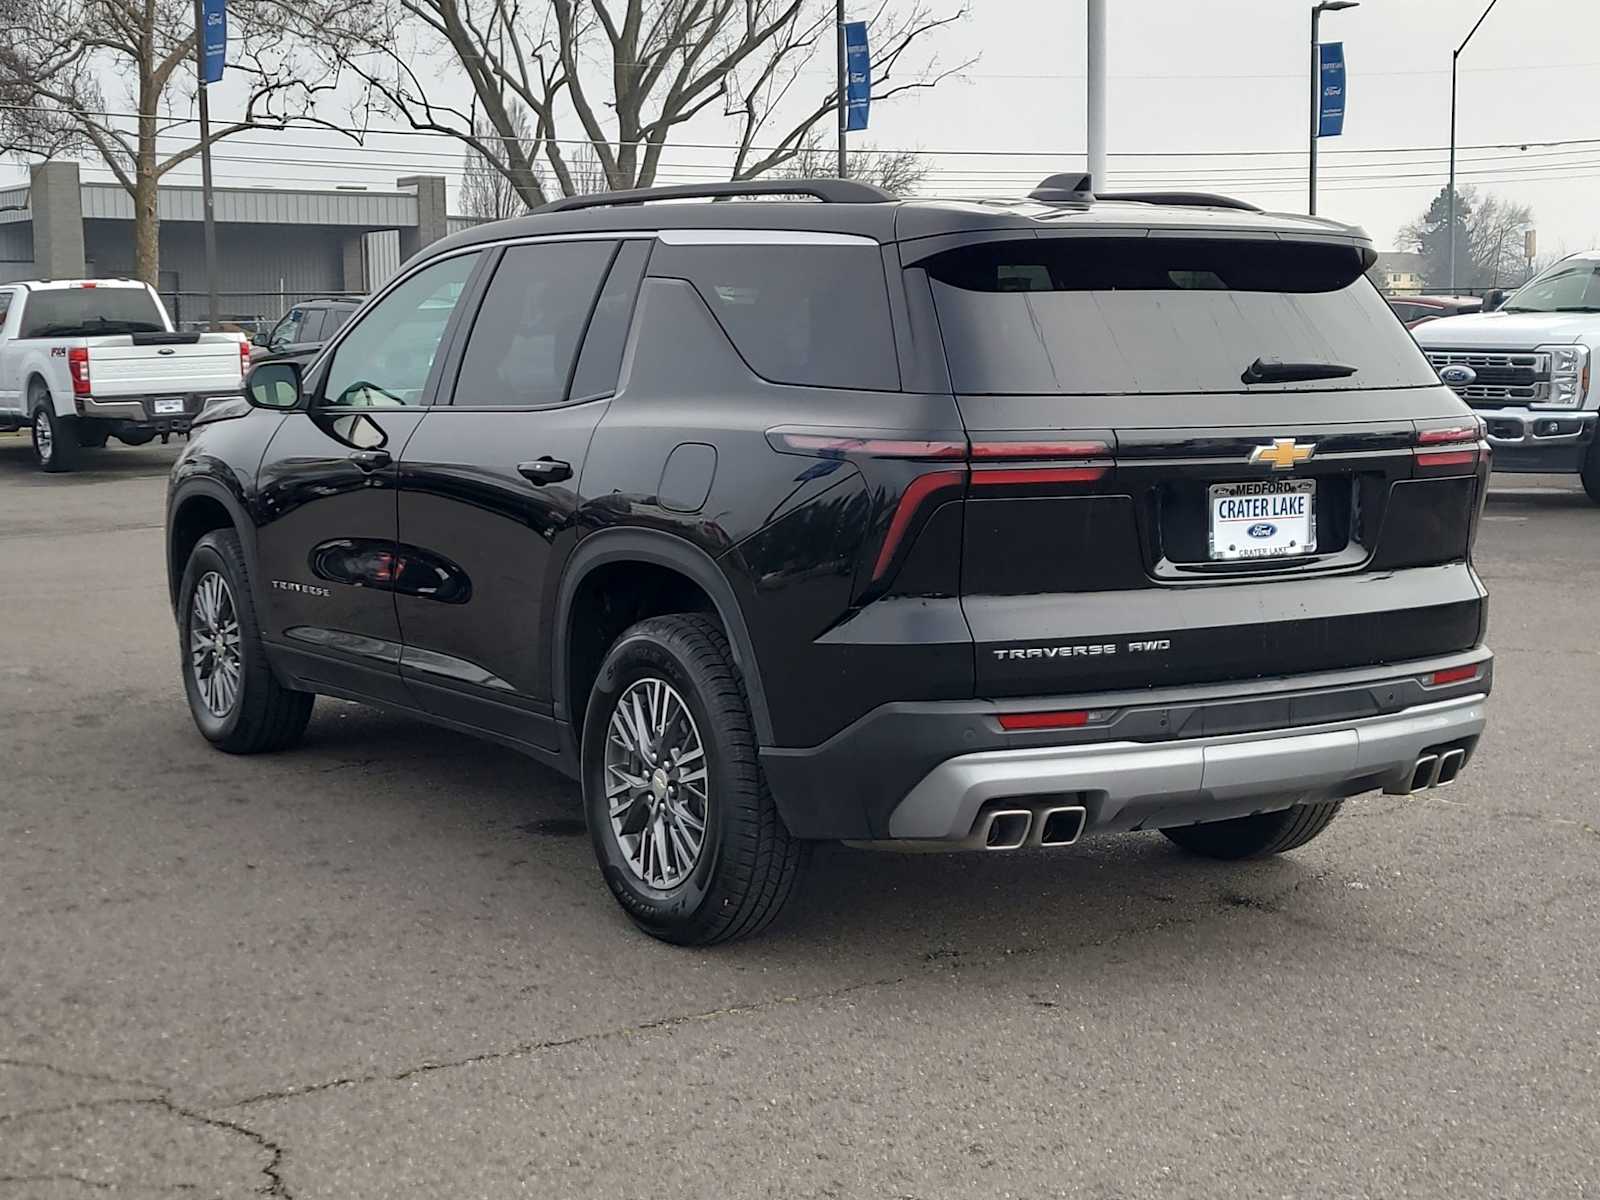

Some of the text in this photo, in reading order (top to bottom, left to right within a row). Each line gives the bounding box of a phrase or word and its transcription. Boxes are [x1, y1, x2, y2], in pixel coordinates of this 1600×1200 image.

[1324, 86, 1342, 96] Ford
[1236, 482, 1291, 496] MEDFORD
[1219, 496, 1305, 518] CRATER LAKE
[1252, 525, 1272, 537] Ford
[1239, 546, 1287, 557] CRATER LAKE
[271, 580, 331, 597] TRAVERSE
[993, 639, 1171, 659] TRAVERSE AWD
